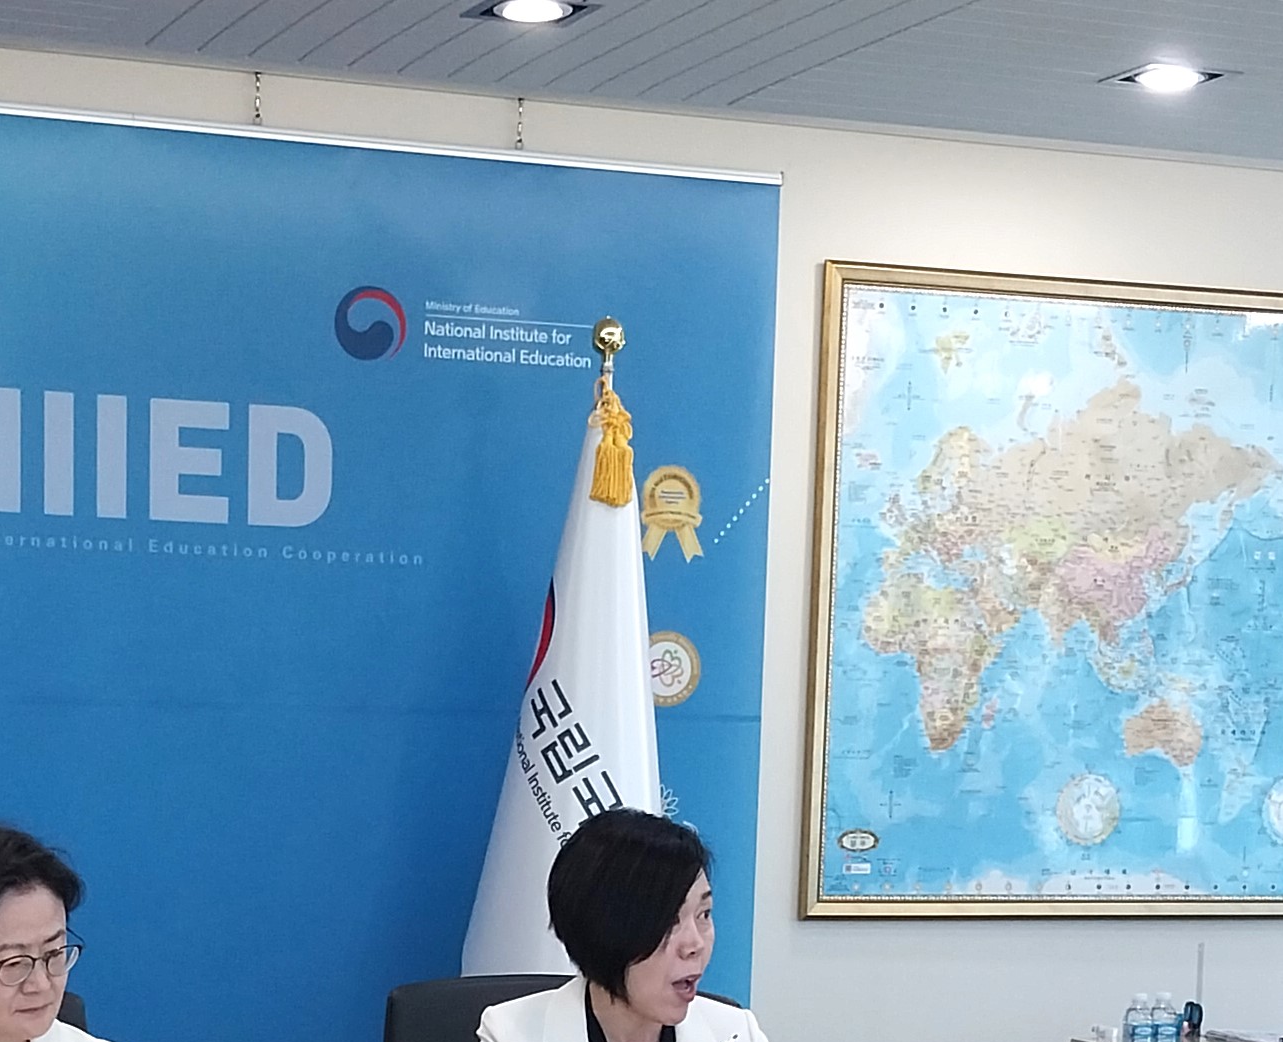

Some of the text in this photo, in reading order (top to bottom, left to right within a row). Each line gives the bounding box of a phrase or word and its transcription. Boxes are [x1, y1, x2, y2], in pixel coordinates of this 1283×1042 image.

[425, 300, 520, 316] Ministry of Education
[424, 320, 572, 345] National Institute for
[424, 343, 592, 369] International Education
[148, 538, 269, 558] Education
[281, 545, 424, 565] Cooperation
[527, 773, 562, 833] Institute
